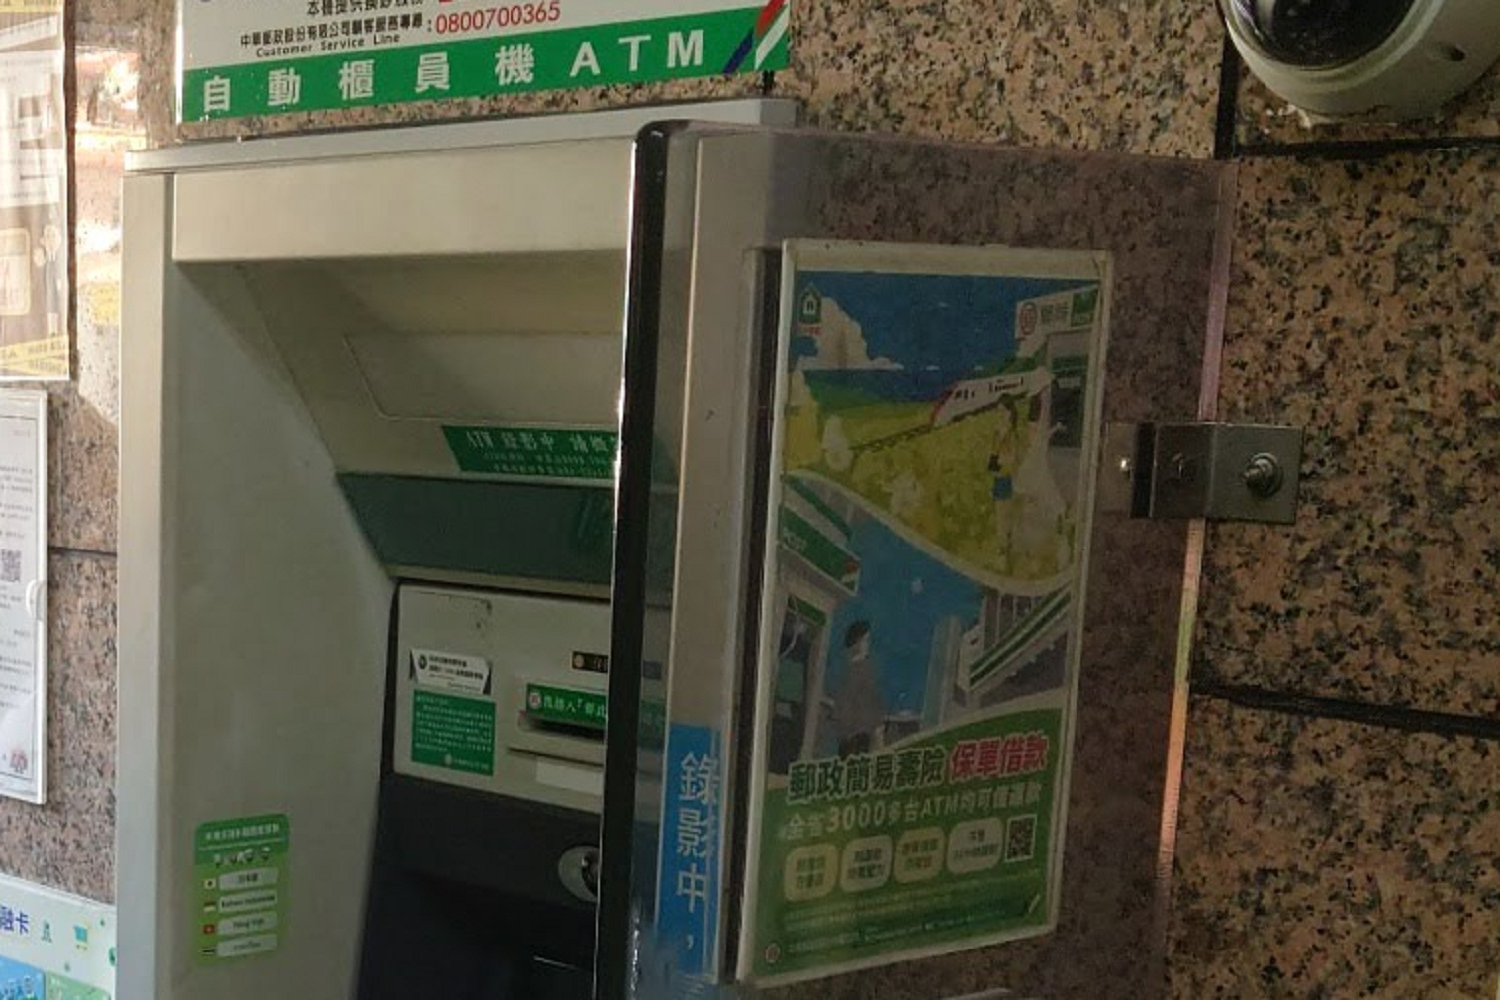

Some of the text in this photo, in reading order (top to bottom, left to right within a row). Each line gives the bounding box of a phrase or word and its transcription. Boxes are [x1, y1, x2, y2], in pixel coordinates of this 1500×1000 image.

[436, 1, 561, 34] 0800700365
[202, 29, 705, 113] 自動櫃員機 ATM
[256, 33, 401, 58] Customer Service Line
[786, 730, 1050, 805] 郵政簡易壽險 保單借款
